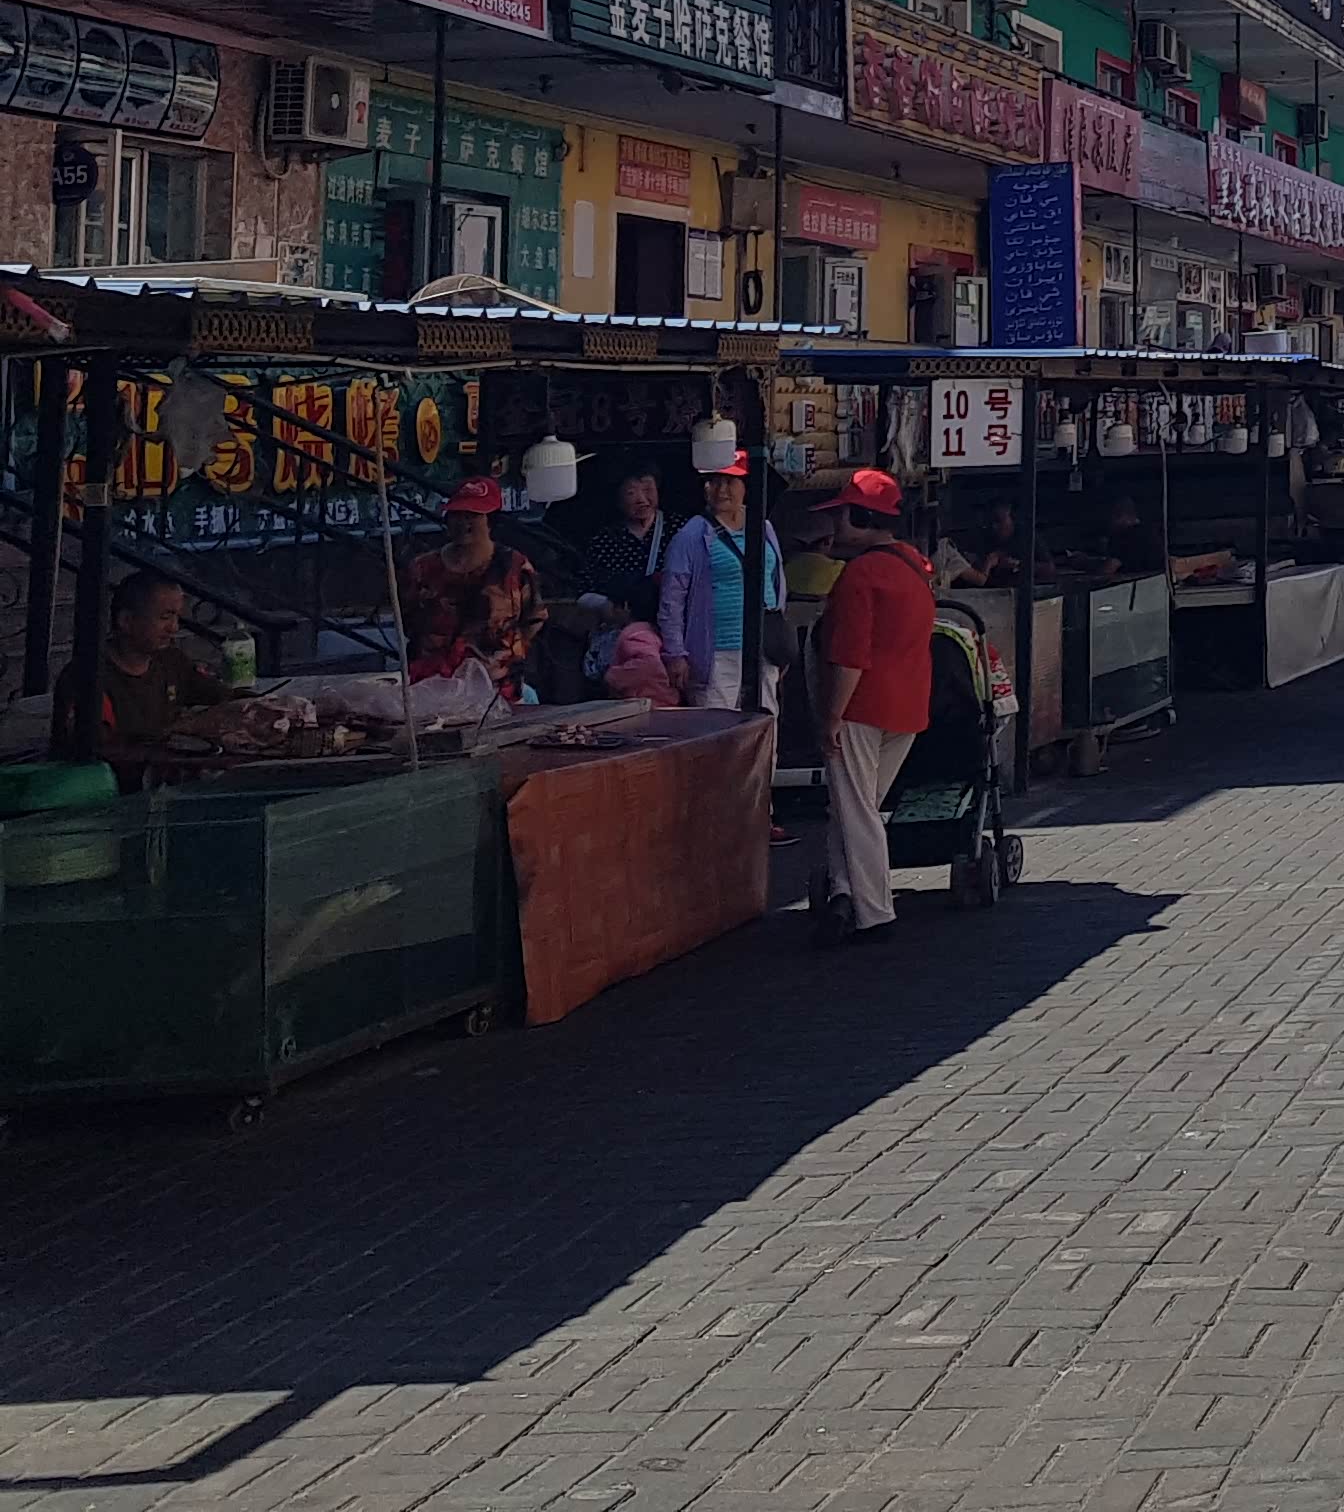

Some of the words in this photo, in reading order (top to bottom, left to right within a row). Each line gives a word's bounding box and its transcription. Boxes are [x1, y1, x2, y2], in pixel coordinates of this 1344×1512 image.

[375, 116, 551, 179] 麦子萨克餐馆
[52, 165, 89, 186] A55
[942, 389, 970, 420] 10
[984, 388, 1013, 420] 号
[941, 426, 967, 457] 11
[983, 424, 1012, 456] 号
